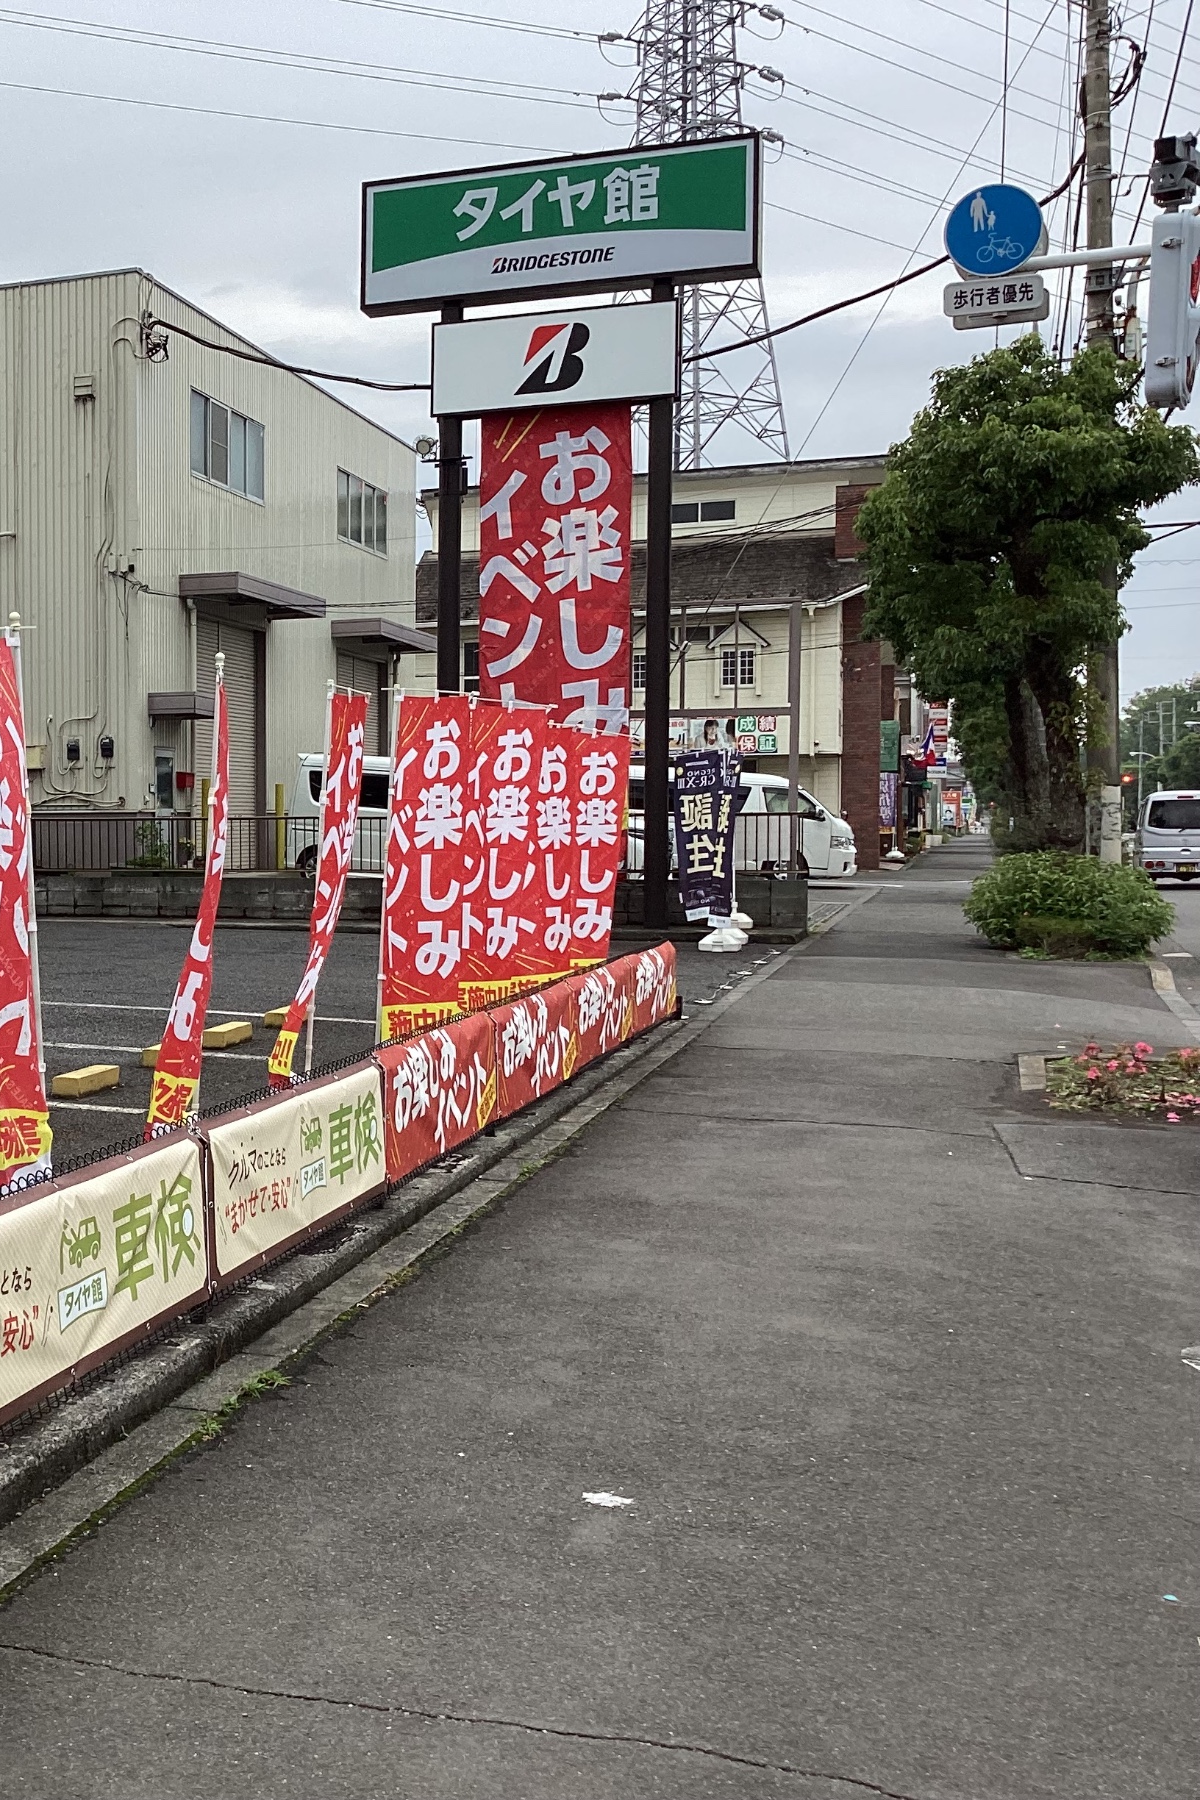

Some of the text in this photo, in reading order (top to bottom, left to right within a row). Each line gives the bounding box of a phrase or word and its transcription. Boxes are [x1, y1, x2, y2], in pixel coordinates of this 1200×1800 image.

[453, 164, 660, 241] タイヤ館
[491, 246, 615, 274] BRIDGESTONE
[953, 282, 1034, 310] 歩行者優先
[539, 426, 630, 738] お楽しみ
[738, 735, 776, 752] 保証
[386, 747, 418, 968] イベント
[414, 718, 463, 979] お楽しみ
[461, 753, 488, 949] イベント
[486, 728, 533, 960] お楽しみ
[538, 746, 571, 953] お楽しみ
[573, 751, 618, 942] お楽しみ
[393, 1029, 457, 1133] お楽しみ
[502, 994, 548, 1078] お楽しみ
[530, 1015, 570, 1097] イベント
[328, 1090, 383, 1185] 車検
[434, 1052, 487, 1153] イベント
[228, 1140, 286, 1190] クルマのことなら
[303, 1162, 324, 1189] タイヤ館
[112, 1172, 201, 1301] 車検
[64, 1277, 103, 1318] タイヤ館
